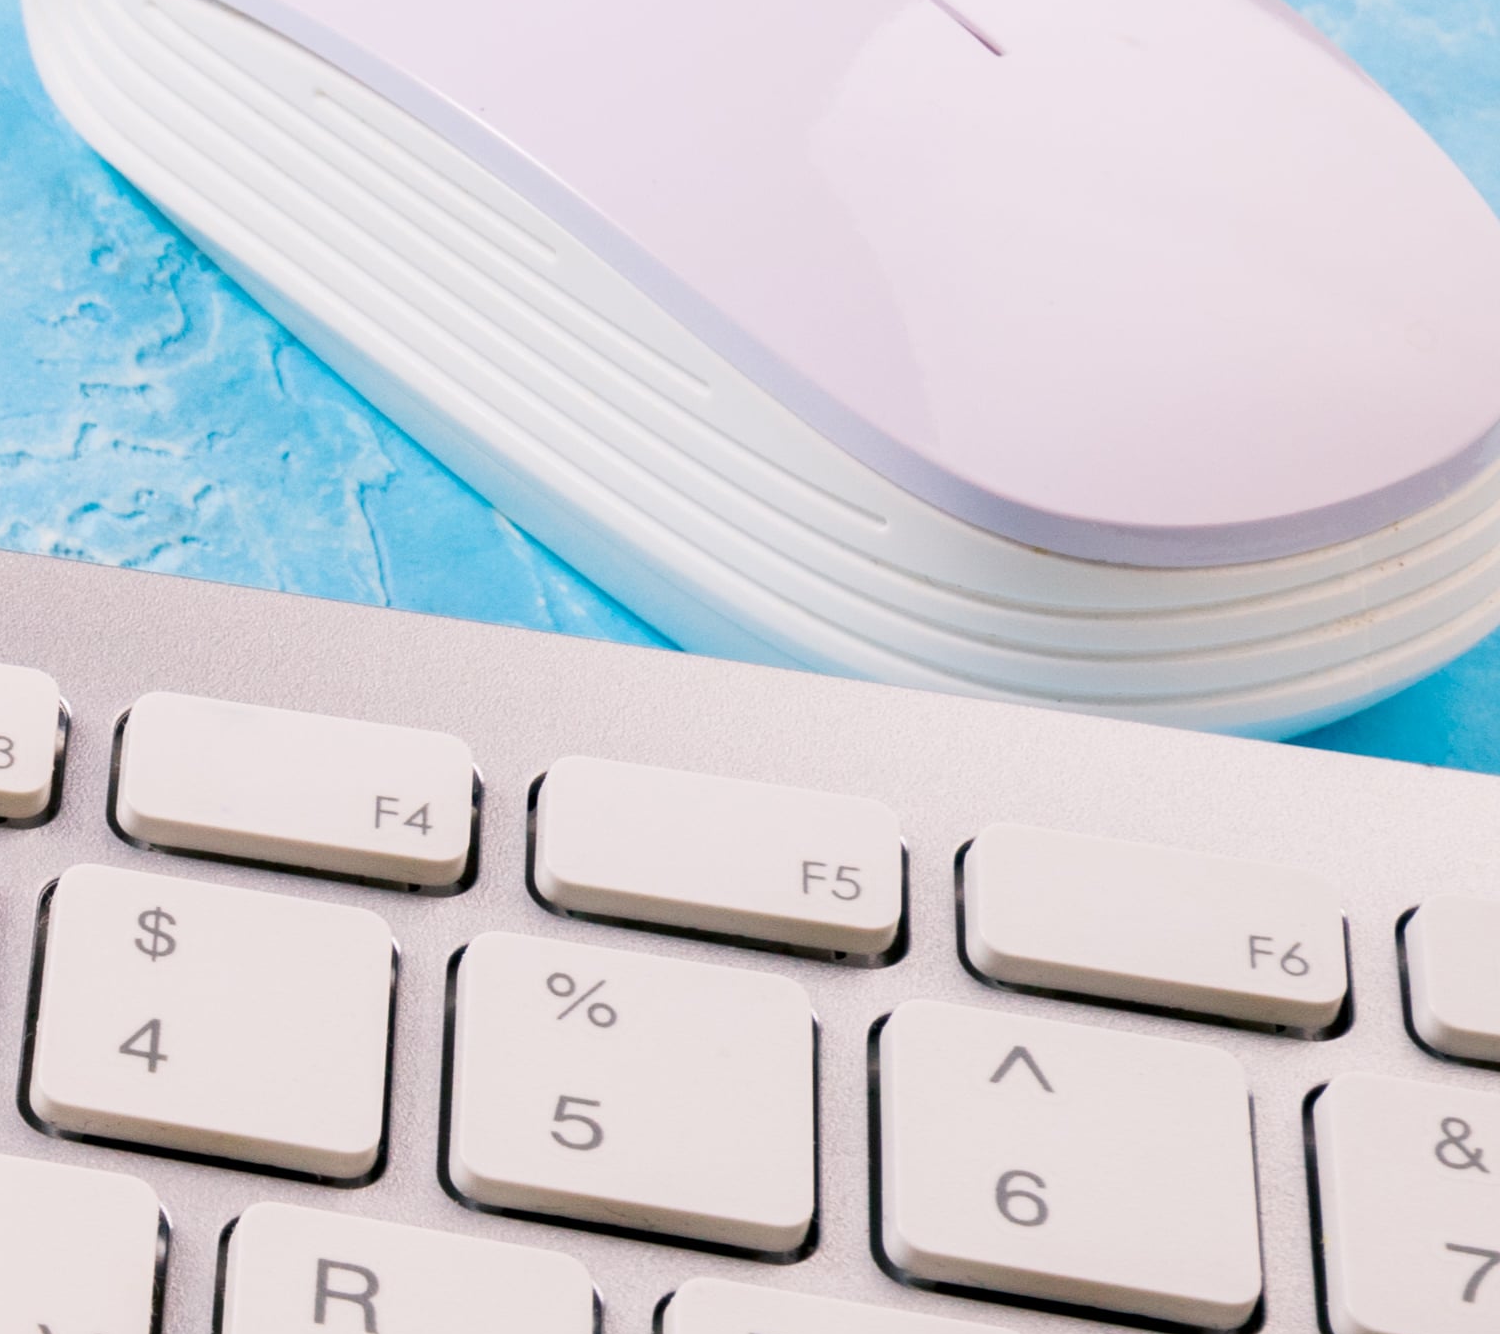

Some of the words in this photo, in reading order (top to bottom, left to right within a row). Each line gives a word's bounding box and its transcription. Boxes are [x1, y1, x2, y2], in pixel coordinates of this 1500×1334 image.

[374, 795, 433, 836] F4
[801, 860, 863, 902] F5
[134, 906, 177, 962] $
[1247, 934, 1311, 978] F6
[545, 971, 618, 1029] %
[118, 1018, 168, 1074] 4
[550, 1094, 605, 1152] 5
[1434, 1116, 1489, 1174] &
[994, 1169, 1049, 1228] 6
[313, 1257, 380, 1334] R
[1445, 1242, 1500, 1304] 7
